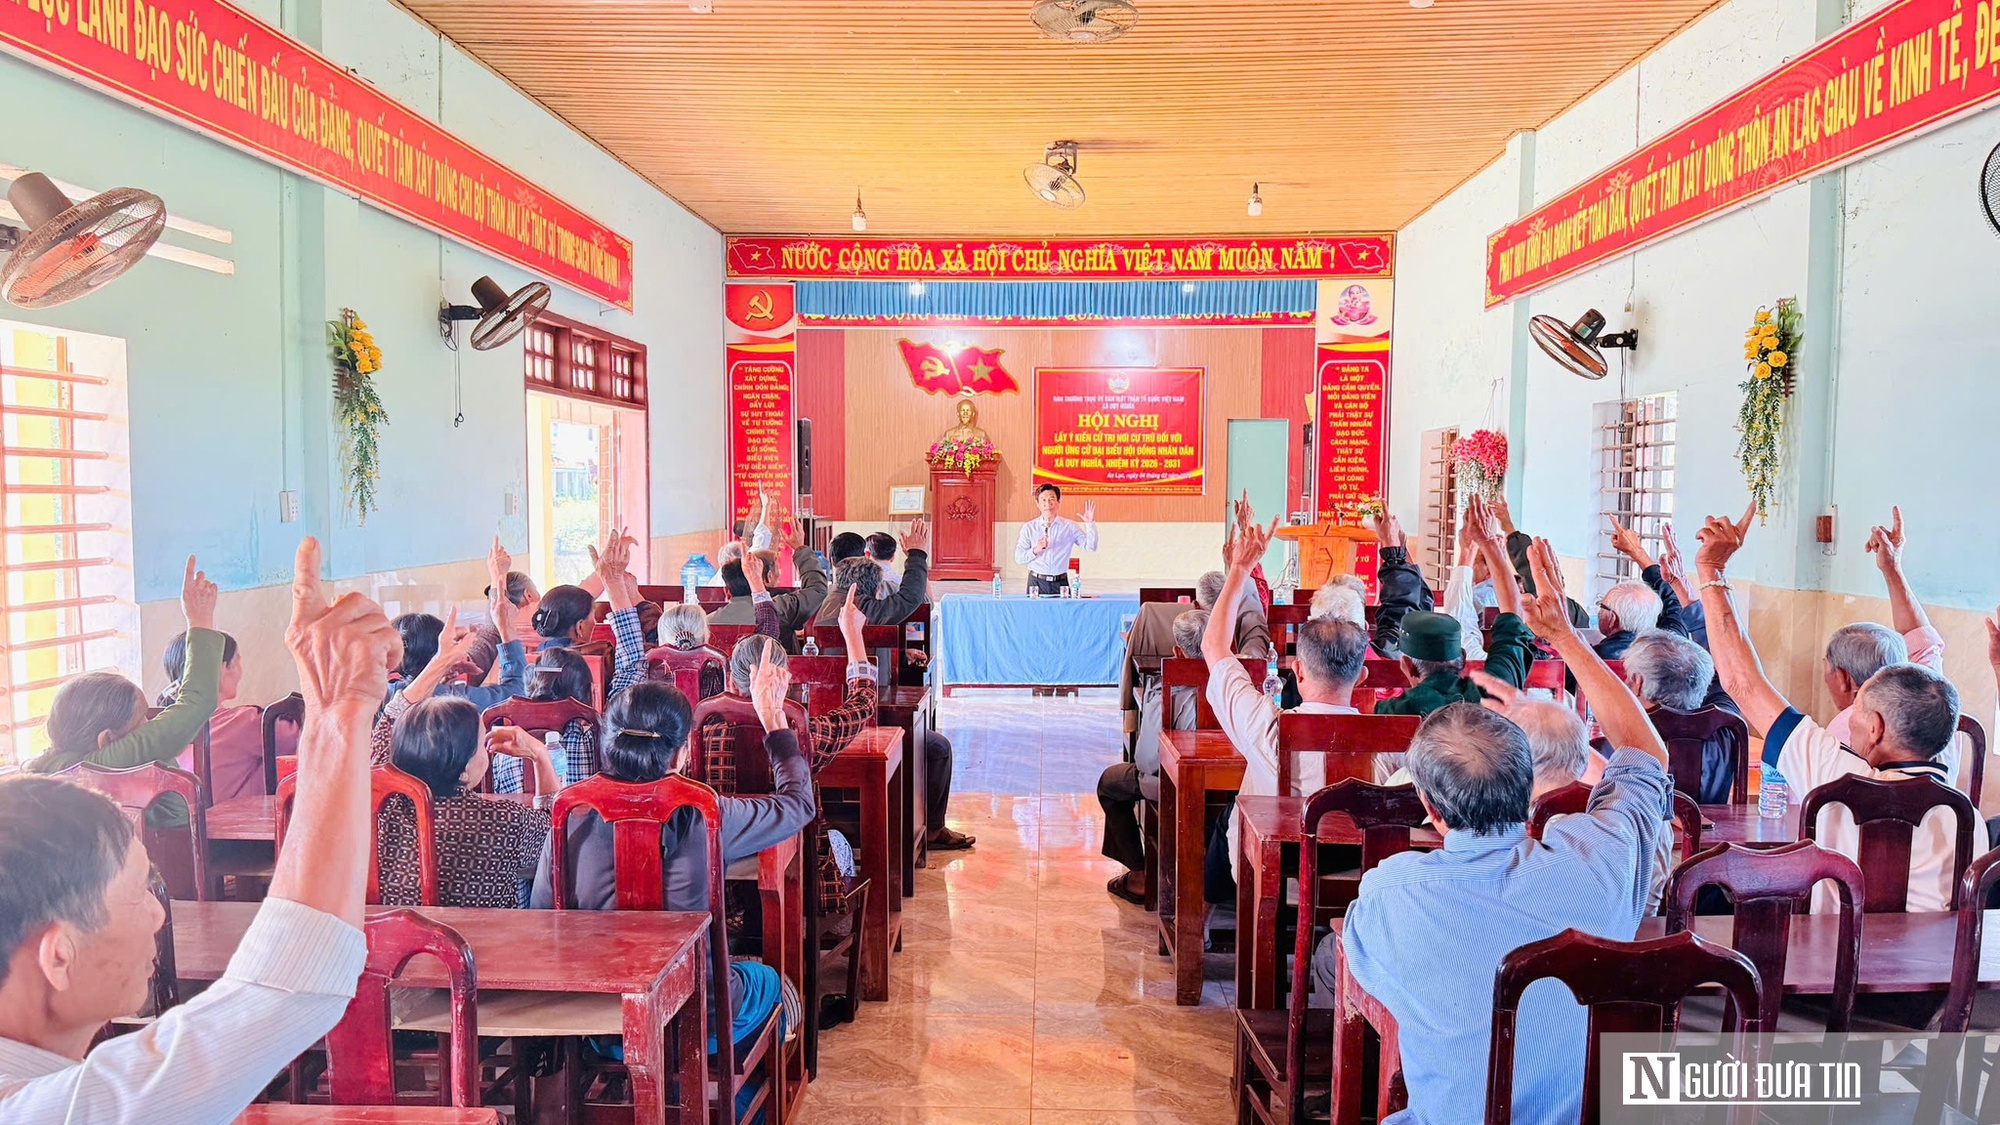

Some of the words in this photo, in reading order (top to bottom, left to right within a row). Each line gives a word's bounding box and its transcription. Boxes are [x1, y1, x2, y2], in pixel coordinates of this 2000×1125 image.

[134, 0, 171, 81] ĐẠO
[176, 10, 208, 92] SỨC
[212, 33, 257, 116] CHIẾN
[261, 52, 288, 130] ĐẤU
[292, 66, 317, 144] CỦA
[320, 82, 354, 171] ĐẢNG,
[357, 112, 390, 178] QUYẾT
[392, 128, 413, 190] TÂM
[415, 140, 433, 199] XÂY
[435, 156, 458, 215] DỰNG
[459, 173, 472, 218] CHI
[474, 173, 485, 232] BỘ
[486, 182, 506, 234] THÔN
[506, 198, 517, 241] AN
[517, 203, 530, 250] LẠC
[531, 206, 547, 259] THẬT
[548, 217, 557, 266] SỰ
[1572, 194, 1588, 252] KẾT
[1588, 189, 1608, 245] TOÀN
[1629, 155, 1658, 232] QUYẾT
[1660, 152, 1681, 213] TÂM
[1681, 139, 1703, 203] XÂY
[1704, 128, 1735, 198] DỰNG
[1737, 104, 1770, 177] THÔN
[1771, 101, 1791, 161] AN
[1793, 86, 1820, 159] LẠC
[1823, 57, 1859, 138] GIÀU
[1863, 26, 1885, 119] VỀ
[1890, 28, 1932, 108] KINH
[781, 241, 832, 270] NƯỚC
[838, 242, 890, 276] CỘNG
[941, 243, 967, 271] XÃ
[972, 243, 1007, 276] HỘI
[1011, 240, 1052, 271] CHỦ
[1058, 243, 1118, 271] NGHĨA
[1123, 242, 1166, 276] VIỆT
[1171, 247, 1212, 271] NAM
[1218, 241, 1273, 271] MUÔN
[1280, 241, 1322, 270] NĂM
[1329, 246, 1335, 269] !
[1078, 411, 1110, 431] HỘI
[1114, 414, 1159, 431] NGHỊ
[1054, 431, 1067, 443] LẤY
[1075, 431, 1092, 443] KIẾN
[1066, 458, 1079, 468] DUY
[1164, 459, 1180, 468] 2031
